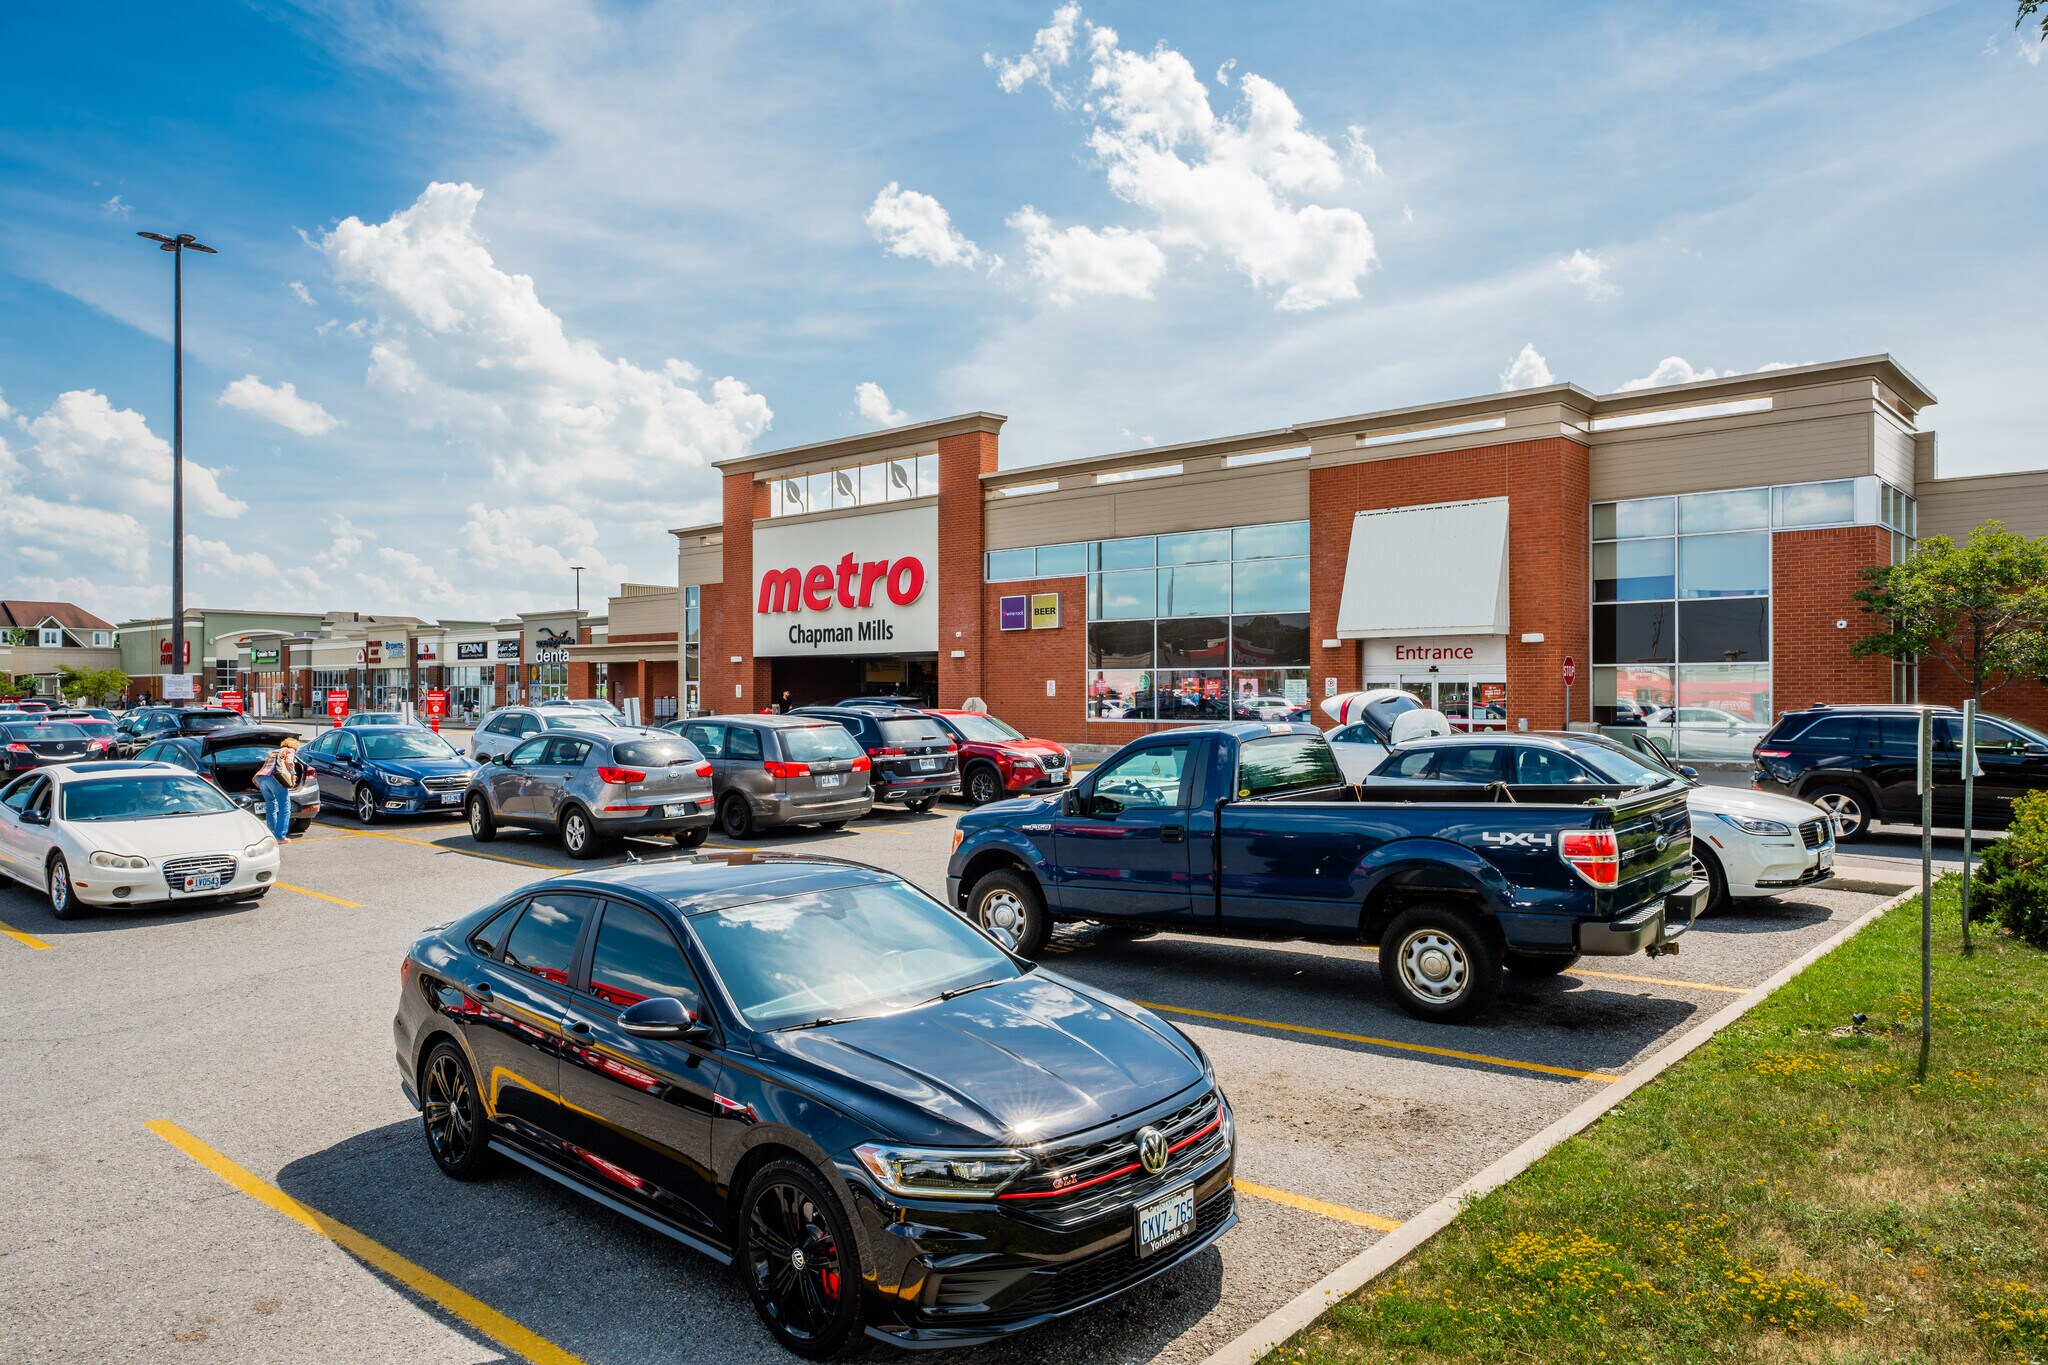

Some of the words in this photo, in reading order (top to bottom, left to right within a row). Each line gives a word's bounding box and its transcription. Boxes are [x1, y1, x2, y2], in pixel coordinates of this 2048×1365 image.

[757, 552, 926, 614] metro
[1034, 607, 1056, 616] BEER
[788, 623, 853, 648] Chapman
[858, 619, 894, 641] Mills
[459, 643, 483, 654] TAN
[1395, 645, 1474, 660] Entrance
[1563, 665, 1575, 677] STOP
[1052, 1173, 1078, 1189] GLI
[1150, 1230, 1181, 1251] Yorkdale
